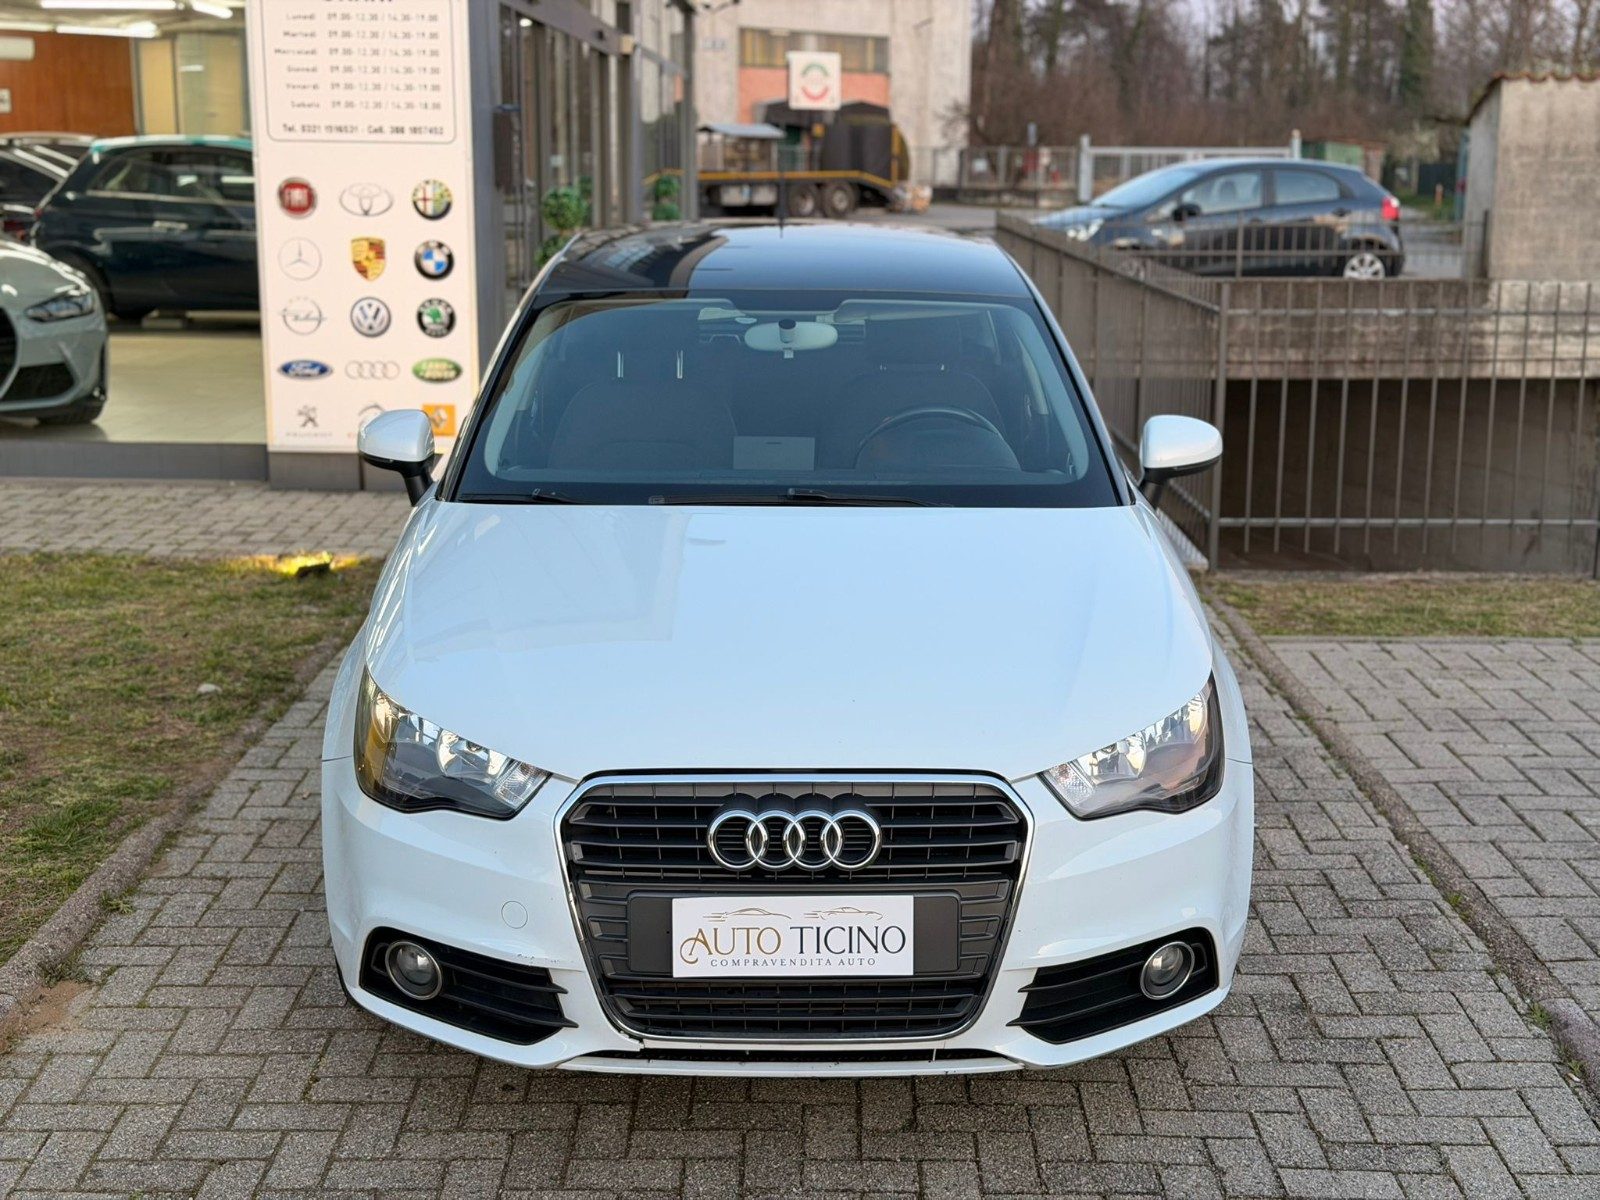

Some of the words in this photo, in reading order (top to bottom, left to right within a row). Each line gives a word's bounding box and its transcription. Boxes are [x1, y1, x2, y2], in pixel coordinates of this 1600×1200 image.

[679, 926, 782, 964] AUTO
[789, 925, 907, 954] TICINO
[710, 958, 832, 967] COMPRAVENDITA
[838, 957, 876, 966] AUTO
